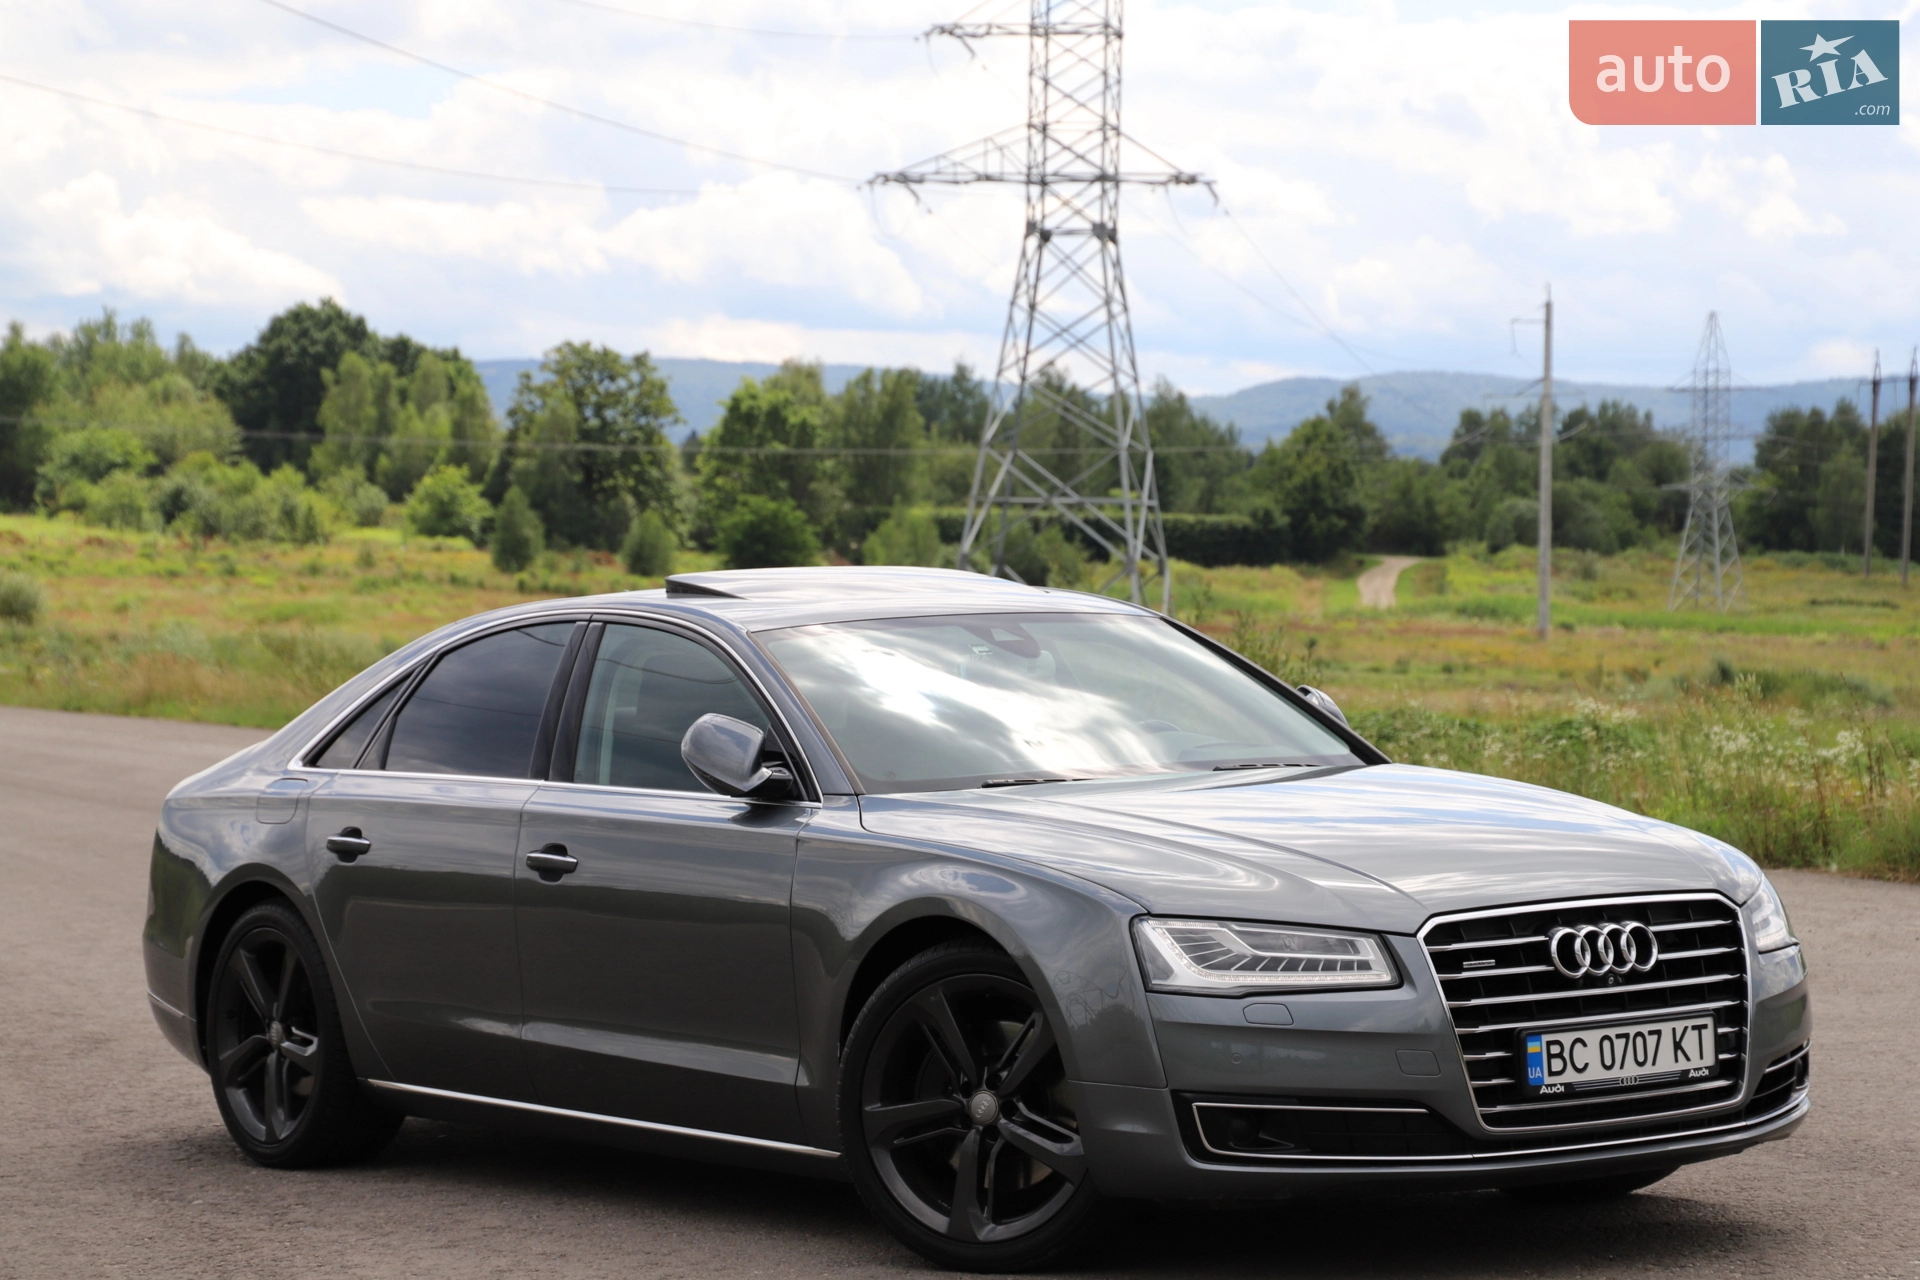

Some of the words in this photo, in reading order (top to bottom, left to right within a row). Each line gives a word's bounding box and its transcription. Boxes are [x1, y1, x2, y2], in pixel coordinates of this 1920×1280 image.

[1546, 1037, 1589, 1078] BC
[1599, 1029, 1662, 1071] 0707
[1672, 1023, 1709, 1064] KT
[1528, 1066, 1543, 1079] UA
[1689, 1067, 1709, 1078] Audi
[1539, 1083, 1565, 1094] Audi
